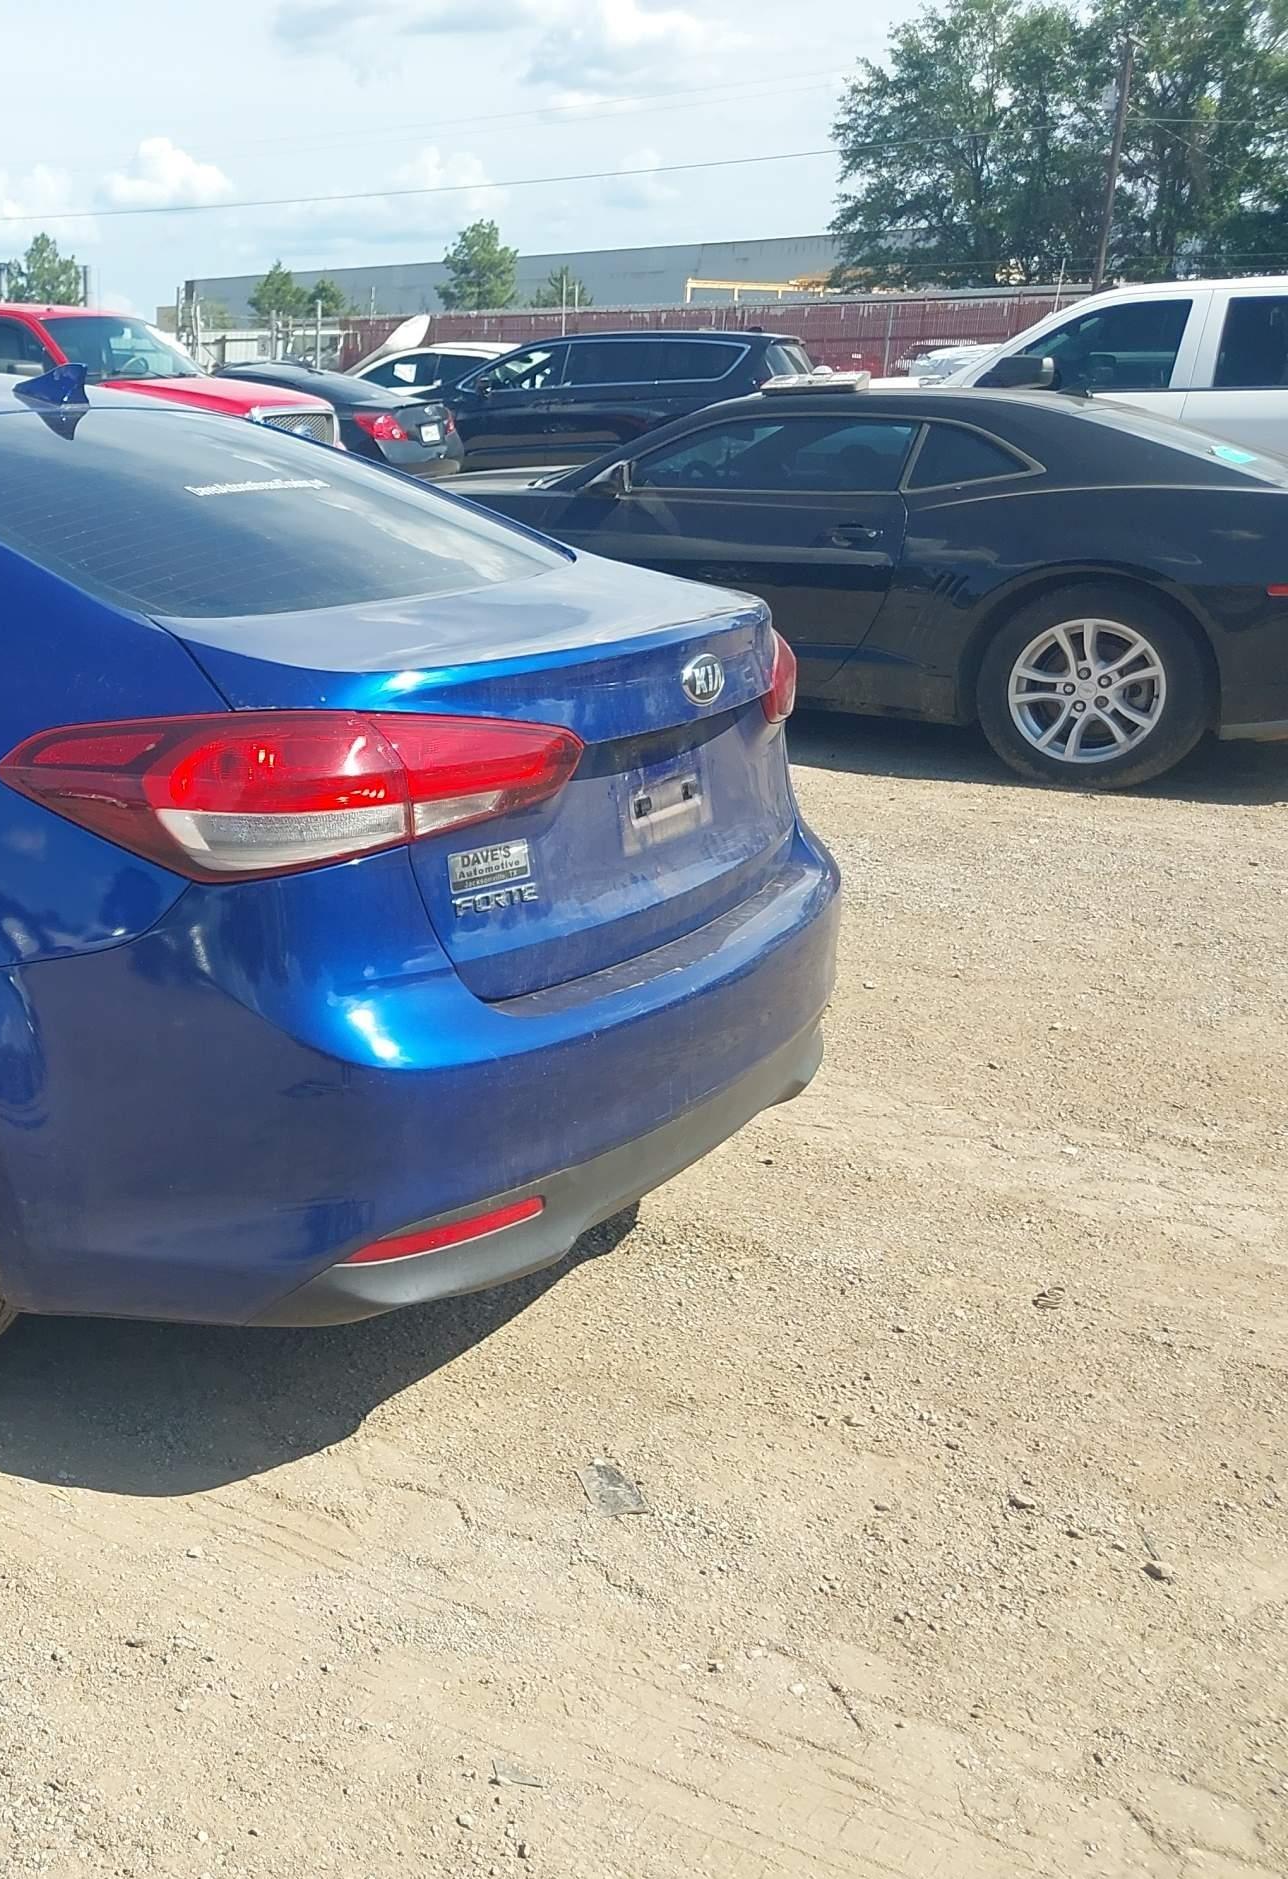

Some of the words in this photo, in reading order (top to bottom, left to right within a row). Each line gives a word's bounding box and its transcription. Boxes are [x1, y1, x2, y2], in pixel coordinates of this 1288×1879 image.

[460, 845, 511, 868] DAVE'S
[458, 859, 520, 880] Automotive
[452, 882, 539, 918] FORTE
